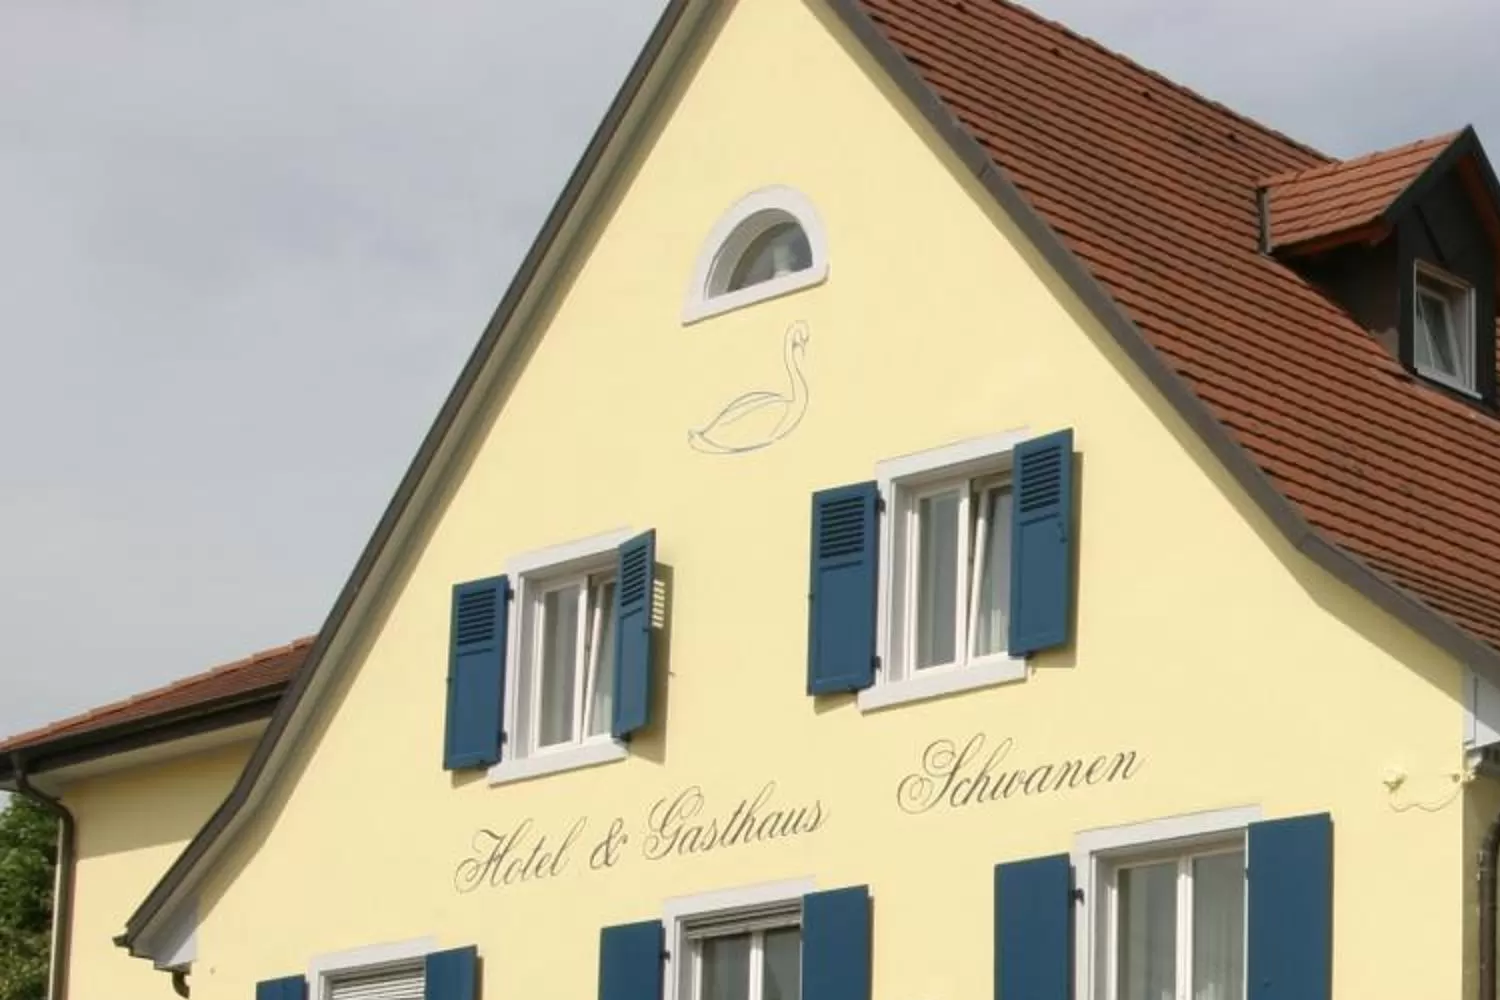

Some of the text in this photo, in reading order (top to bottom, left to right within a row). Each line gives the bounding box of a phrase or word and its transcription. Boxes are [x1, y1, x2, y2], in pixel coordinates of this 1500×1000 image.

[454, 731, 1146, 894] Hotel & Gasthaus Schwanen
